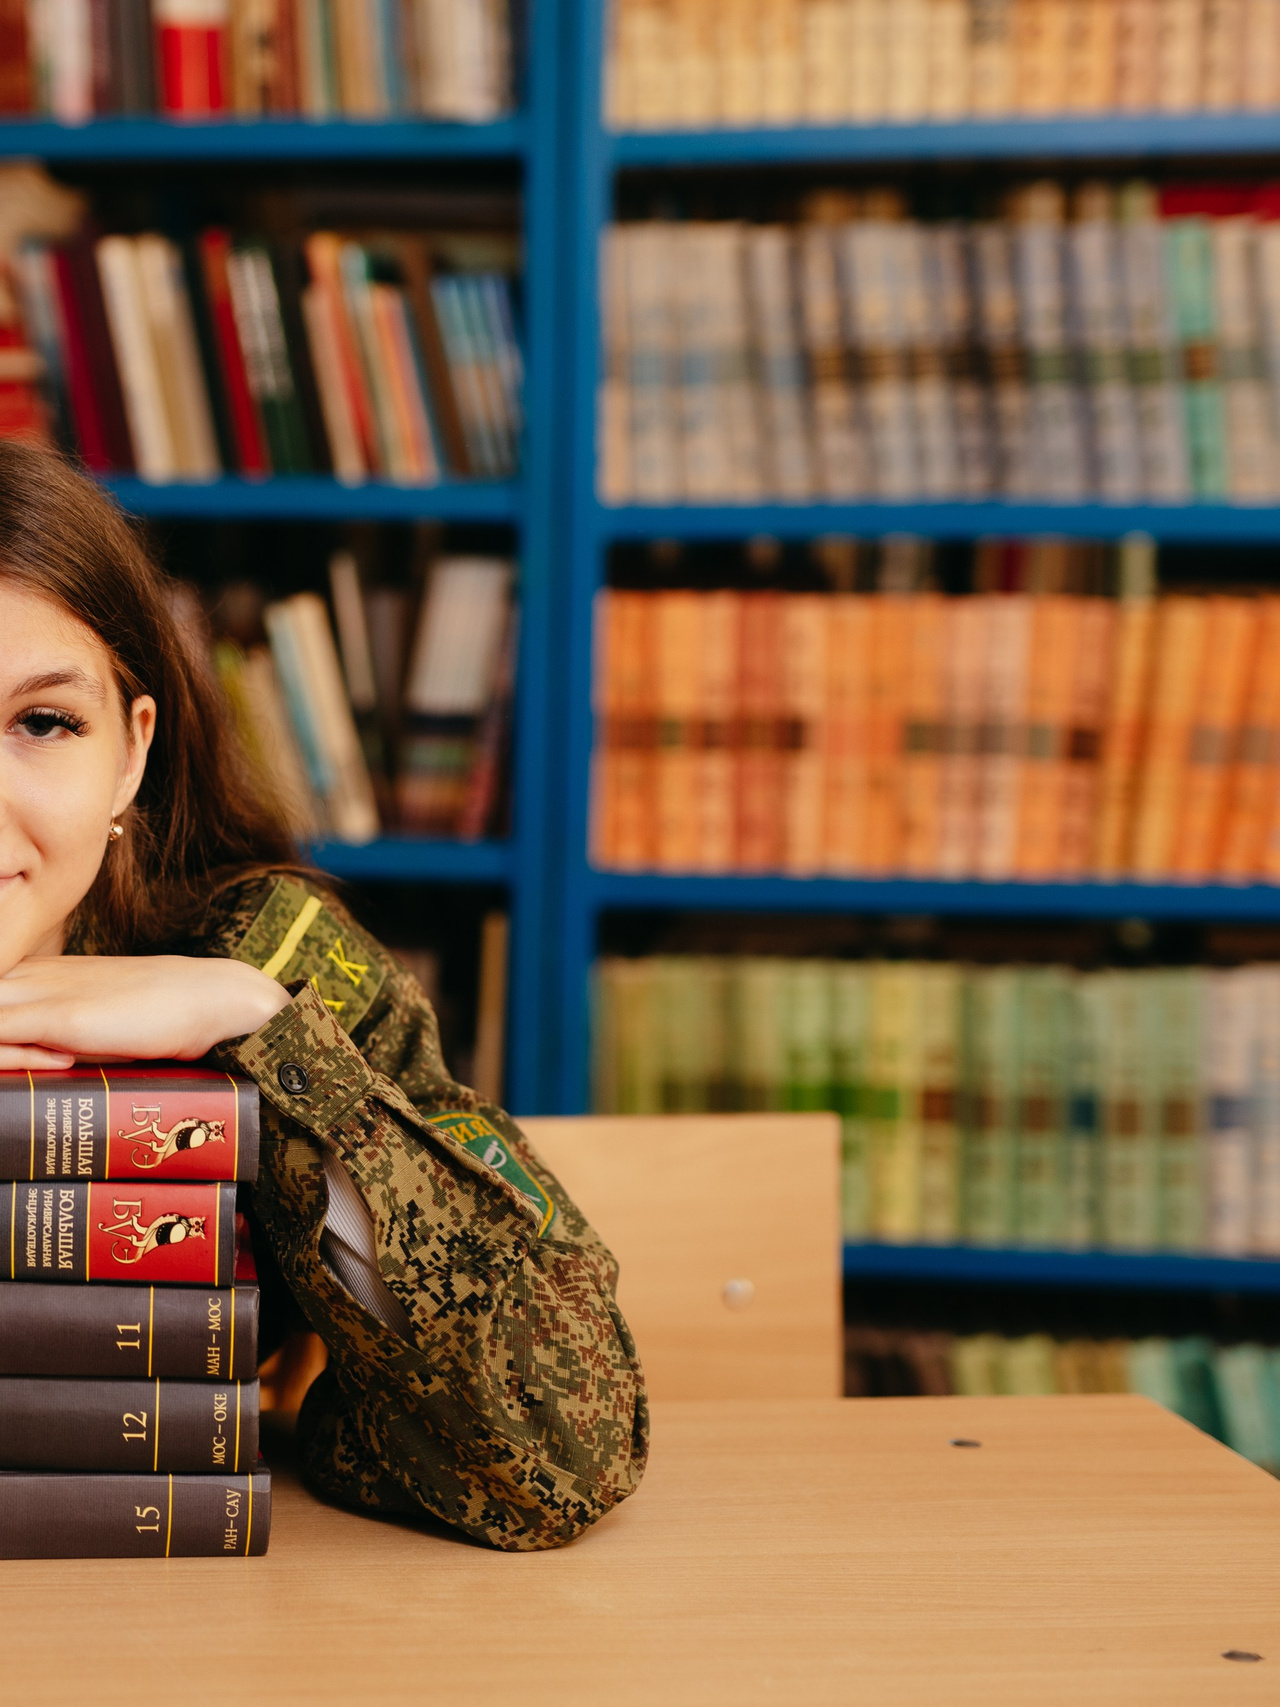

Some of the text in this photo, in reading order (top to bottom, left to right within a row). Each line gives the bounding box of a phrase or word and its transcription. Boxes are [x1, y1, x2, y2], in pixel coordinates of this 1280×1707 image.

[44, 1097, 56, 1175] ЭНЦИКЛОПЕДИЯ
[61, 1097, 72, 1174] УНИВЕРСАЛЬНАЯ
[77, 1097, 94, 1175] БОЛЬШАЯ
[25, 1188, 38, 1268] ЭНЦИКЛОПЕДИЯ
[42, 1188, 54, 1268] УНИВЕРСАЛЬНАЯ
[58, 1189, 75, 1270] БОЛЬШАЯ
[115, 1322, 141, 1351] 11
[122, 1411, 148, 1442] 12
[134, 1505, 160, 1534] 15
